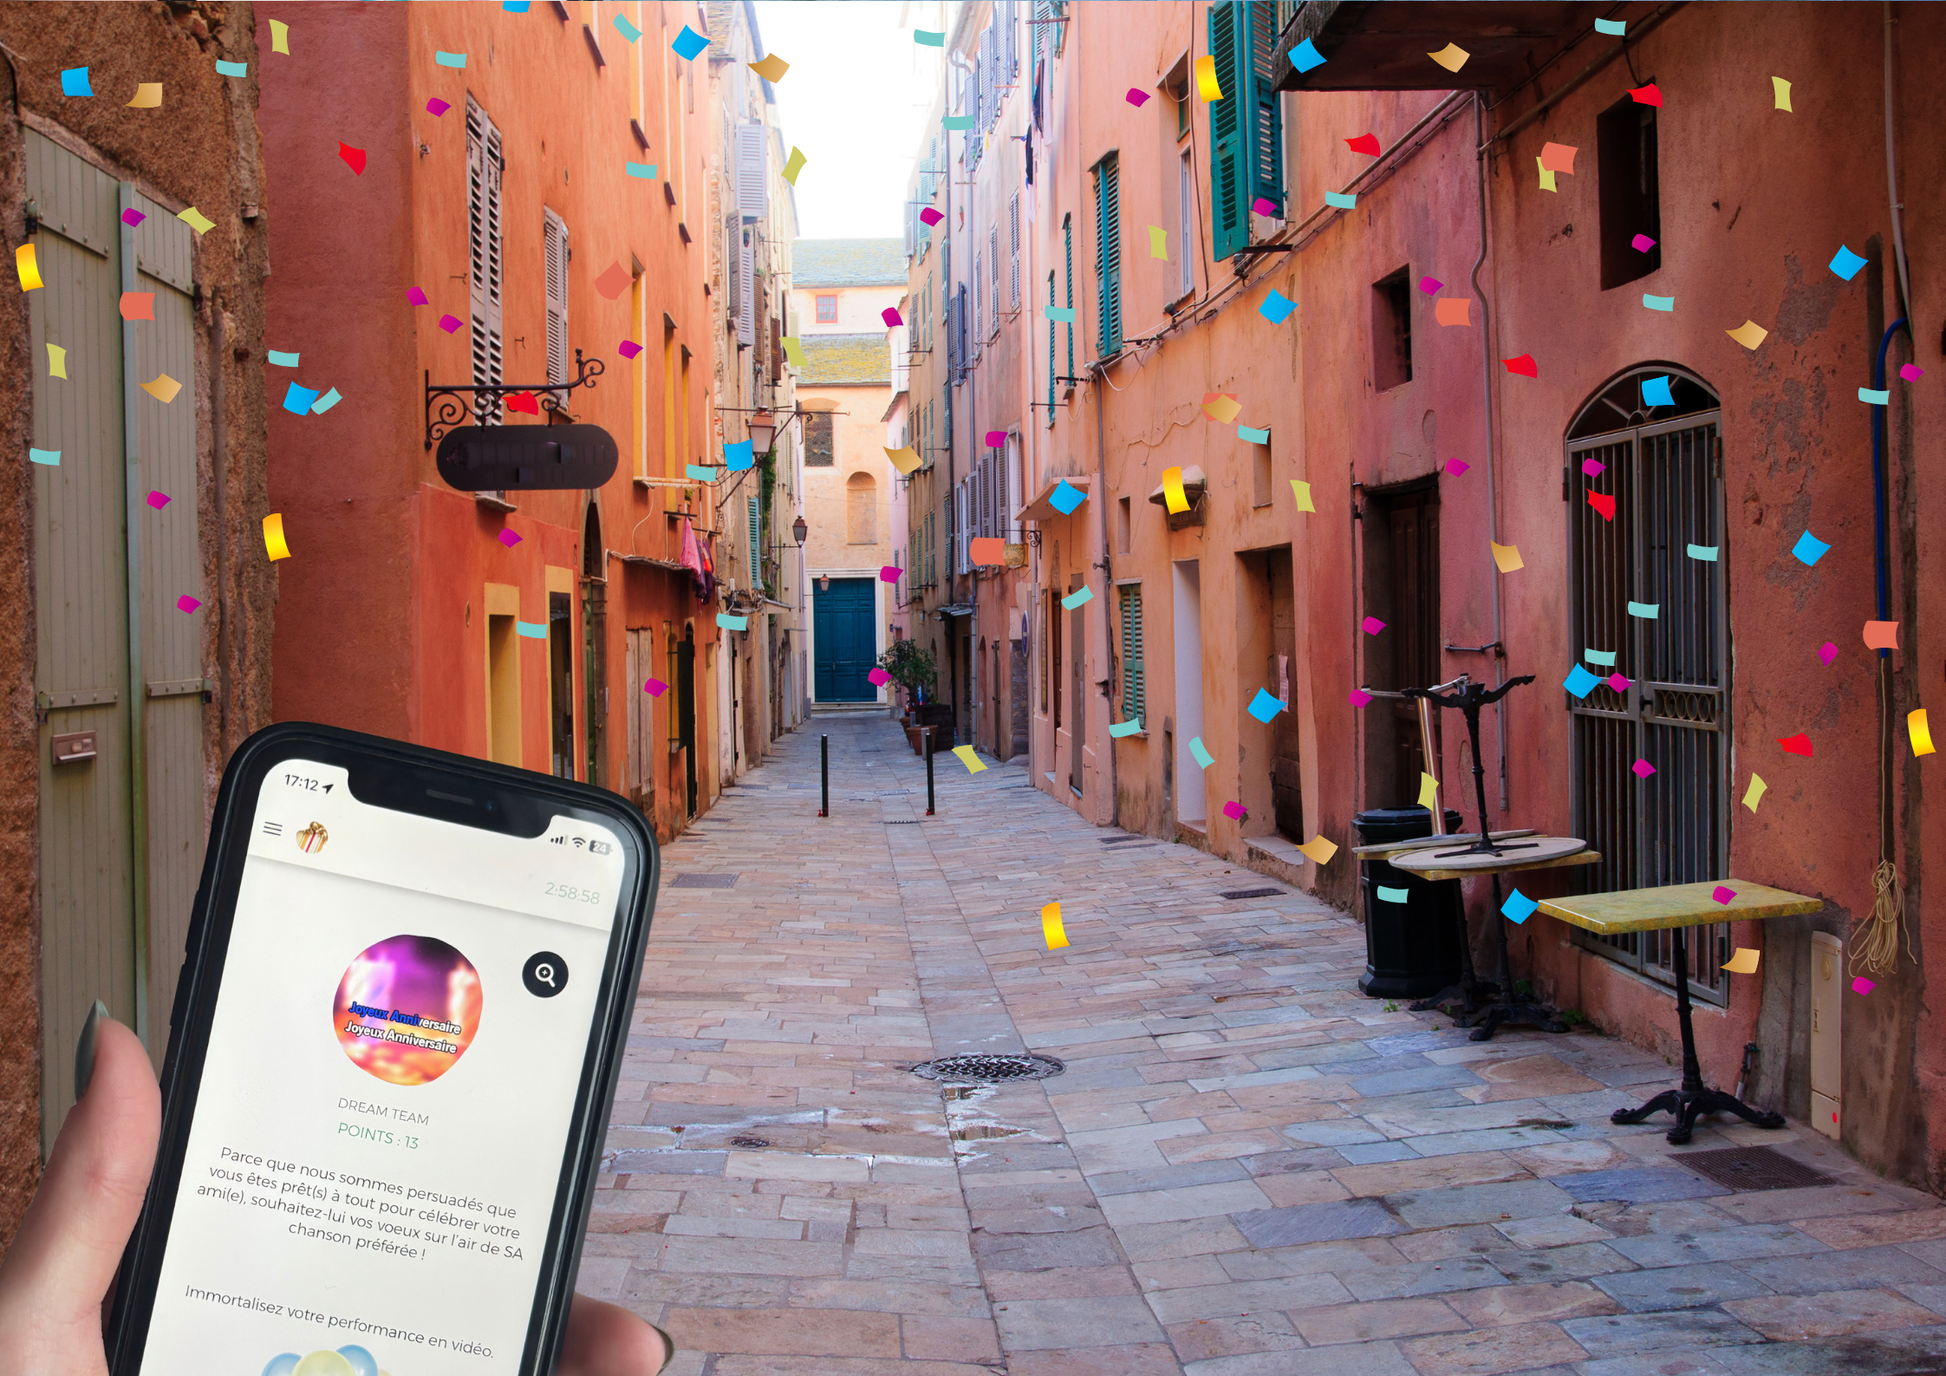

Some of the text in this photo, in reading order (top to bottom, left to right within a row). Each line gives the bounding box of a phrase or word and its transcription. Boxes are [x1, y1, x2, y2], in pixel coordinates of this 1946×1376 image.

[284, 774, 319, 792] 17:12
[592, 842, 606, 853] 24
[545, 882, 600, 904] 2:58:58
[348, 1001, 461, 1035] Joyeux Anniversaire
[344, 1021, 457, 1054] Joyeux Anniversaire
[338, 1098, 430, 1126] DREAM TEAM
[338, 1122, 394, 1144] POINTS
[405, 1136, 419, 1150] 13
[220, 1146, 517, 1218] Parce que nous sommes persuadés que
[209, 1167, 520, 1240] vous êtes prêt(s) à tout pour célébrer votre
[197, 1185, 246, 1205] ami(e),
[250, 1196, 346, 1224] souhaitez-lui
[350, 1216, 373, 1229] vos
[377, 1220, 421, 1240] voeux
[424, 1231, 448, 1244] sur
[480, 1241, 500, 1256] de
[504, 1245, 524, 1260] SA
[288, 1222, 426, 1260] chanson préférée !
[185, 1285, 494, 1359] Immortalisez votre performance en vidéo.
